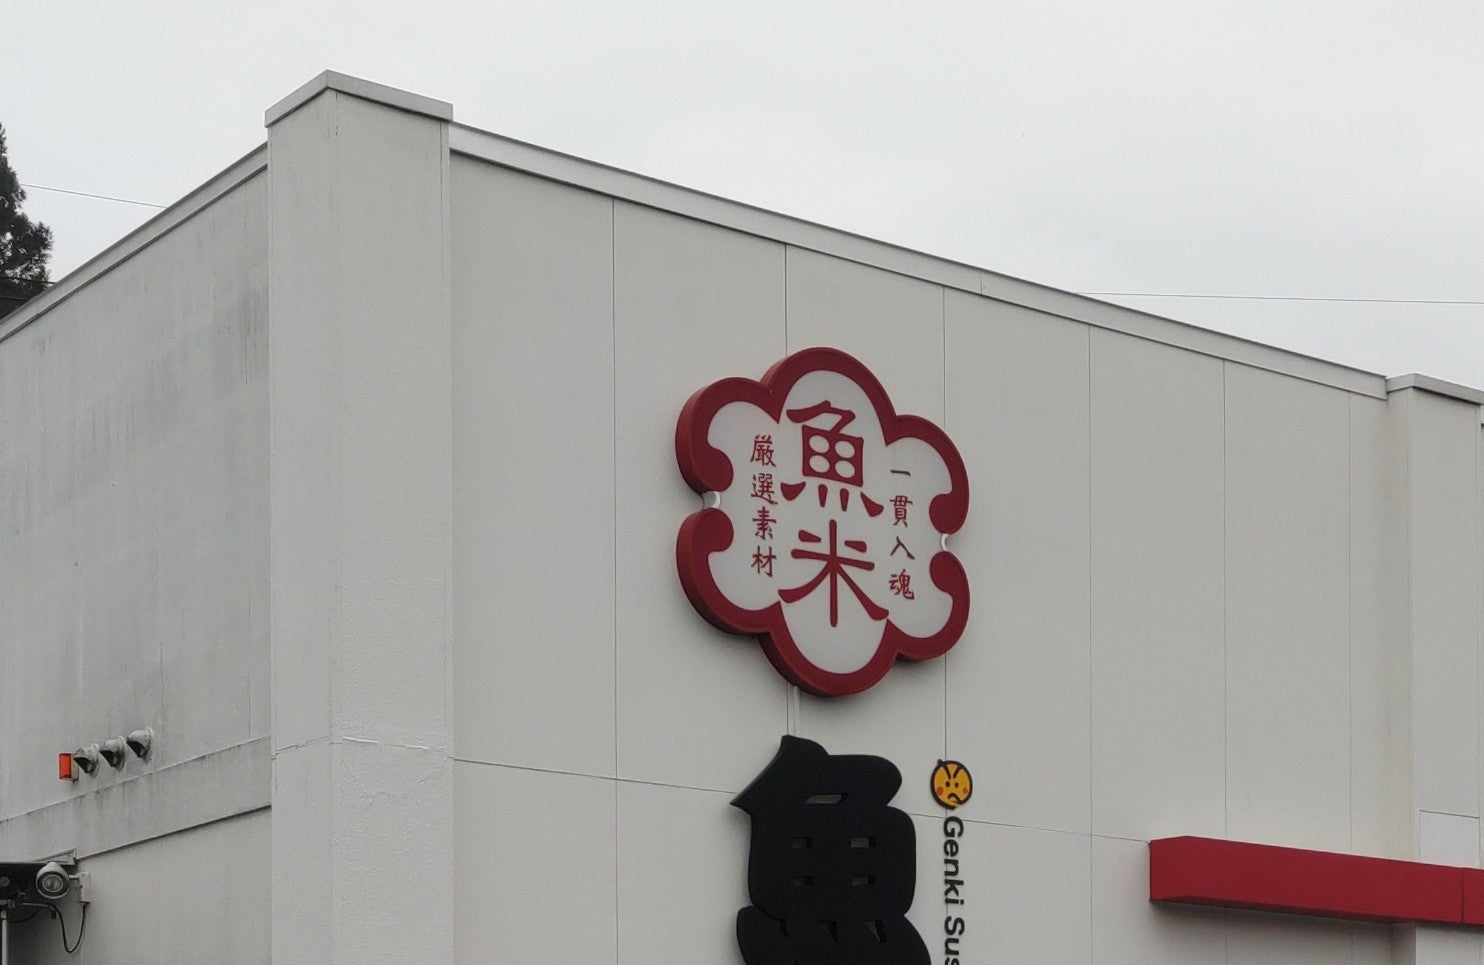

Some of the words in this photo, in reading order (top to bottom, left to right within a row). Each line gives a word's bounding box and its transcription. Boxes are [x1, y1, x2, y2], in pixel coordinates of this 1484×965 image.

[750, 434, 778, 578] 厳選素材
[778, 400, 890, 628] 魚米
[889, 468, 916, 600] 一貫入魂
[943, 816, 965, 905] Genki
